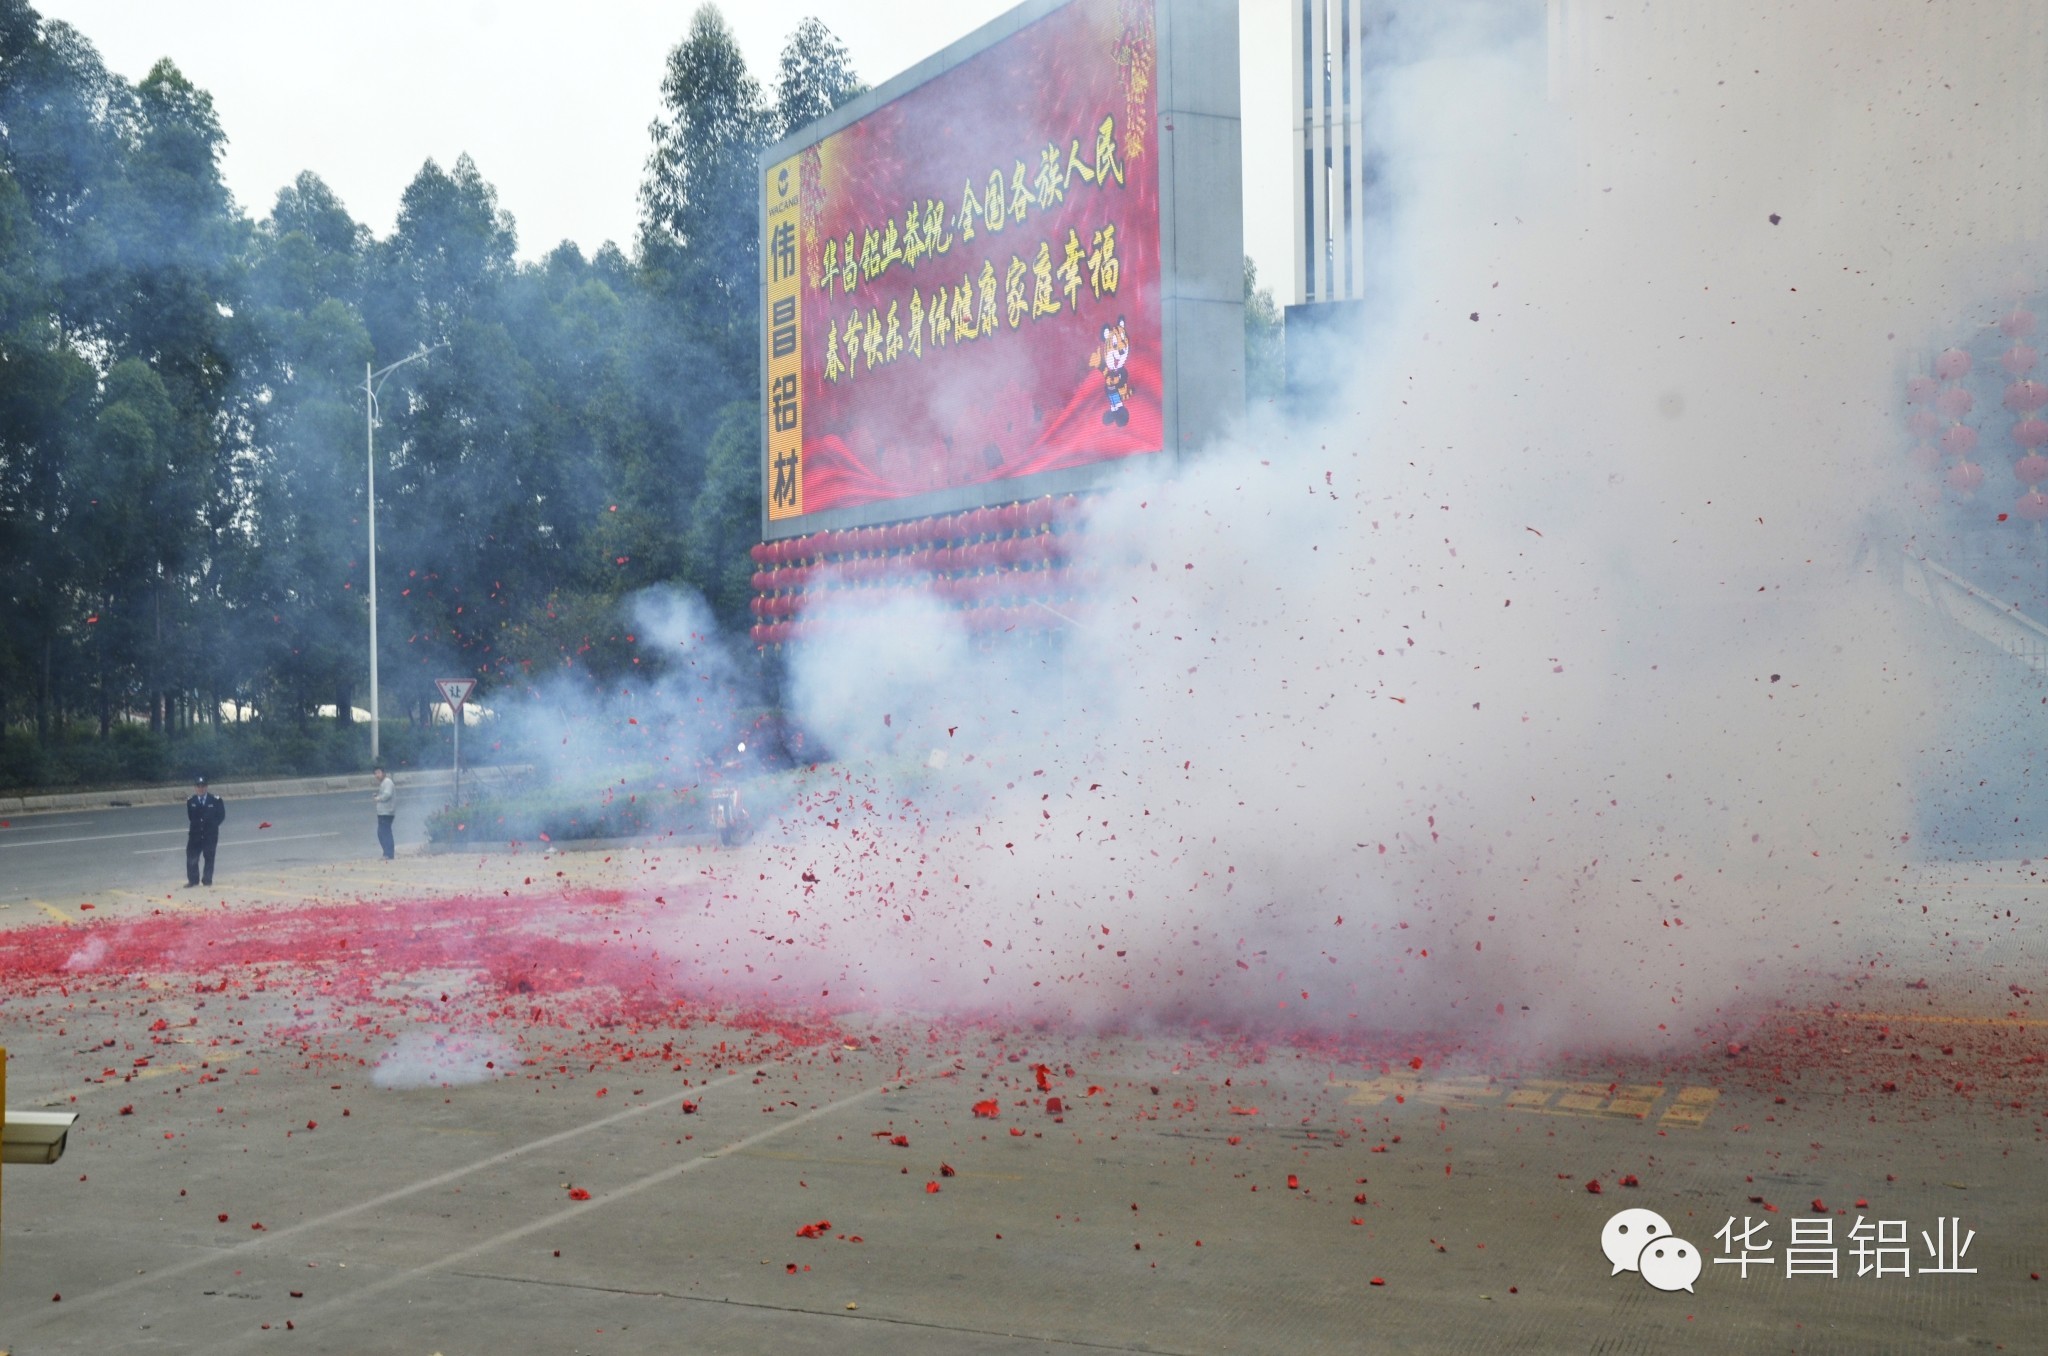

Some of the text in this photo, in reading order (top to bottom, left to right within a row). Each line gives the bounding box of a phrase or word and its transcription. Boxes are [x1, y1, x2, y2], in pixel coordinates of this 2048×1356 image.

[771, 222, 798, 508] 伟昌铝材
[824, 225, 1119, 382] 春节快乐身体健康家庭幸福
[449, 685, 461, 698] 让
